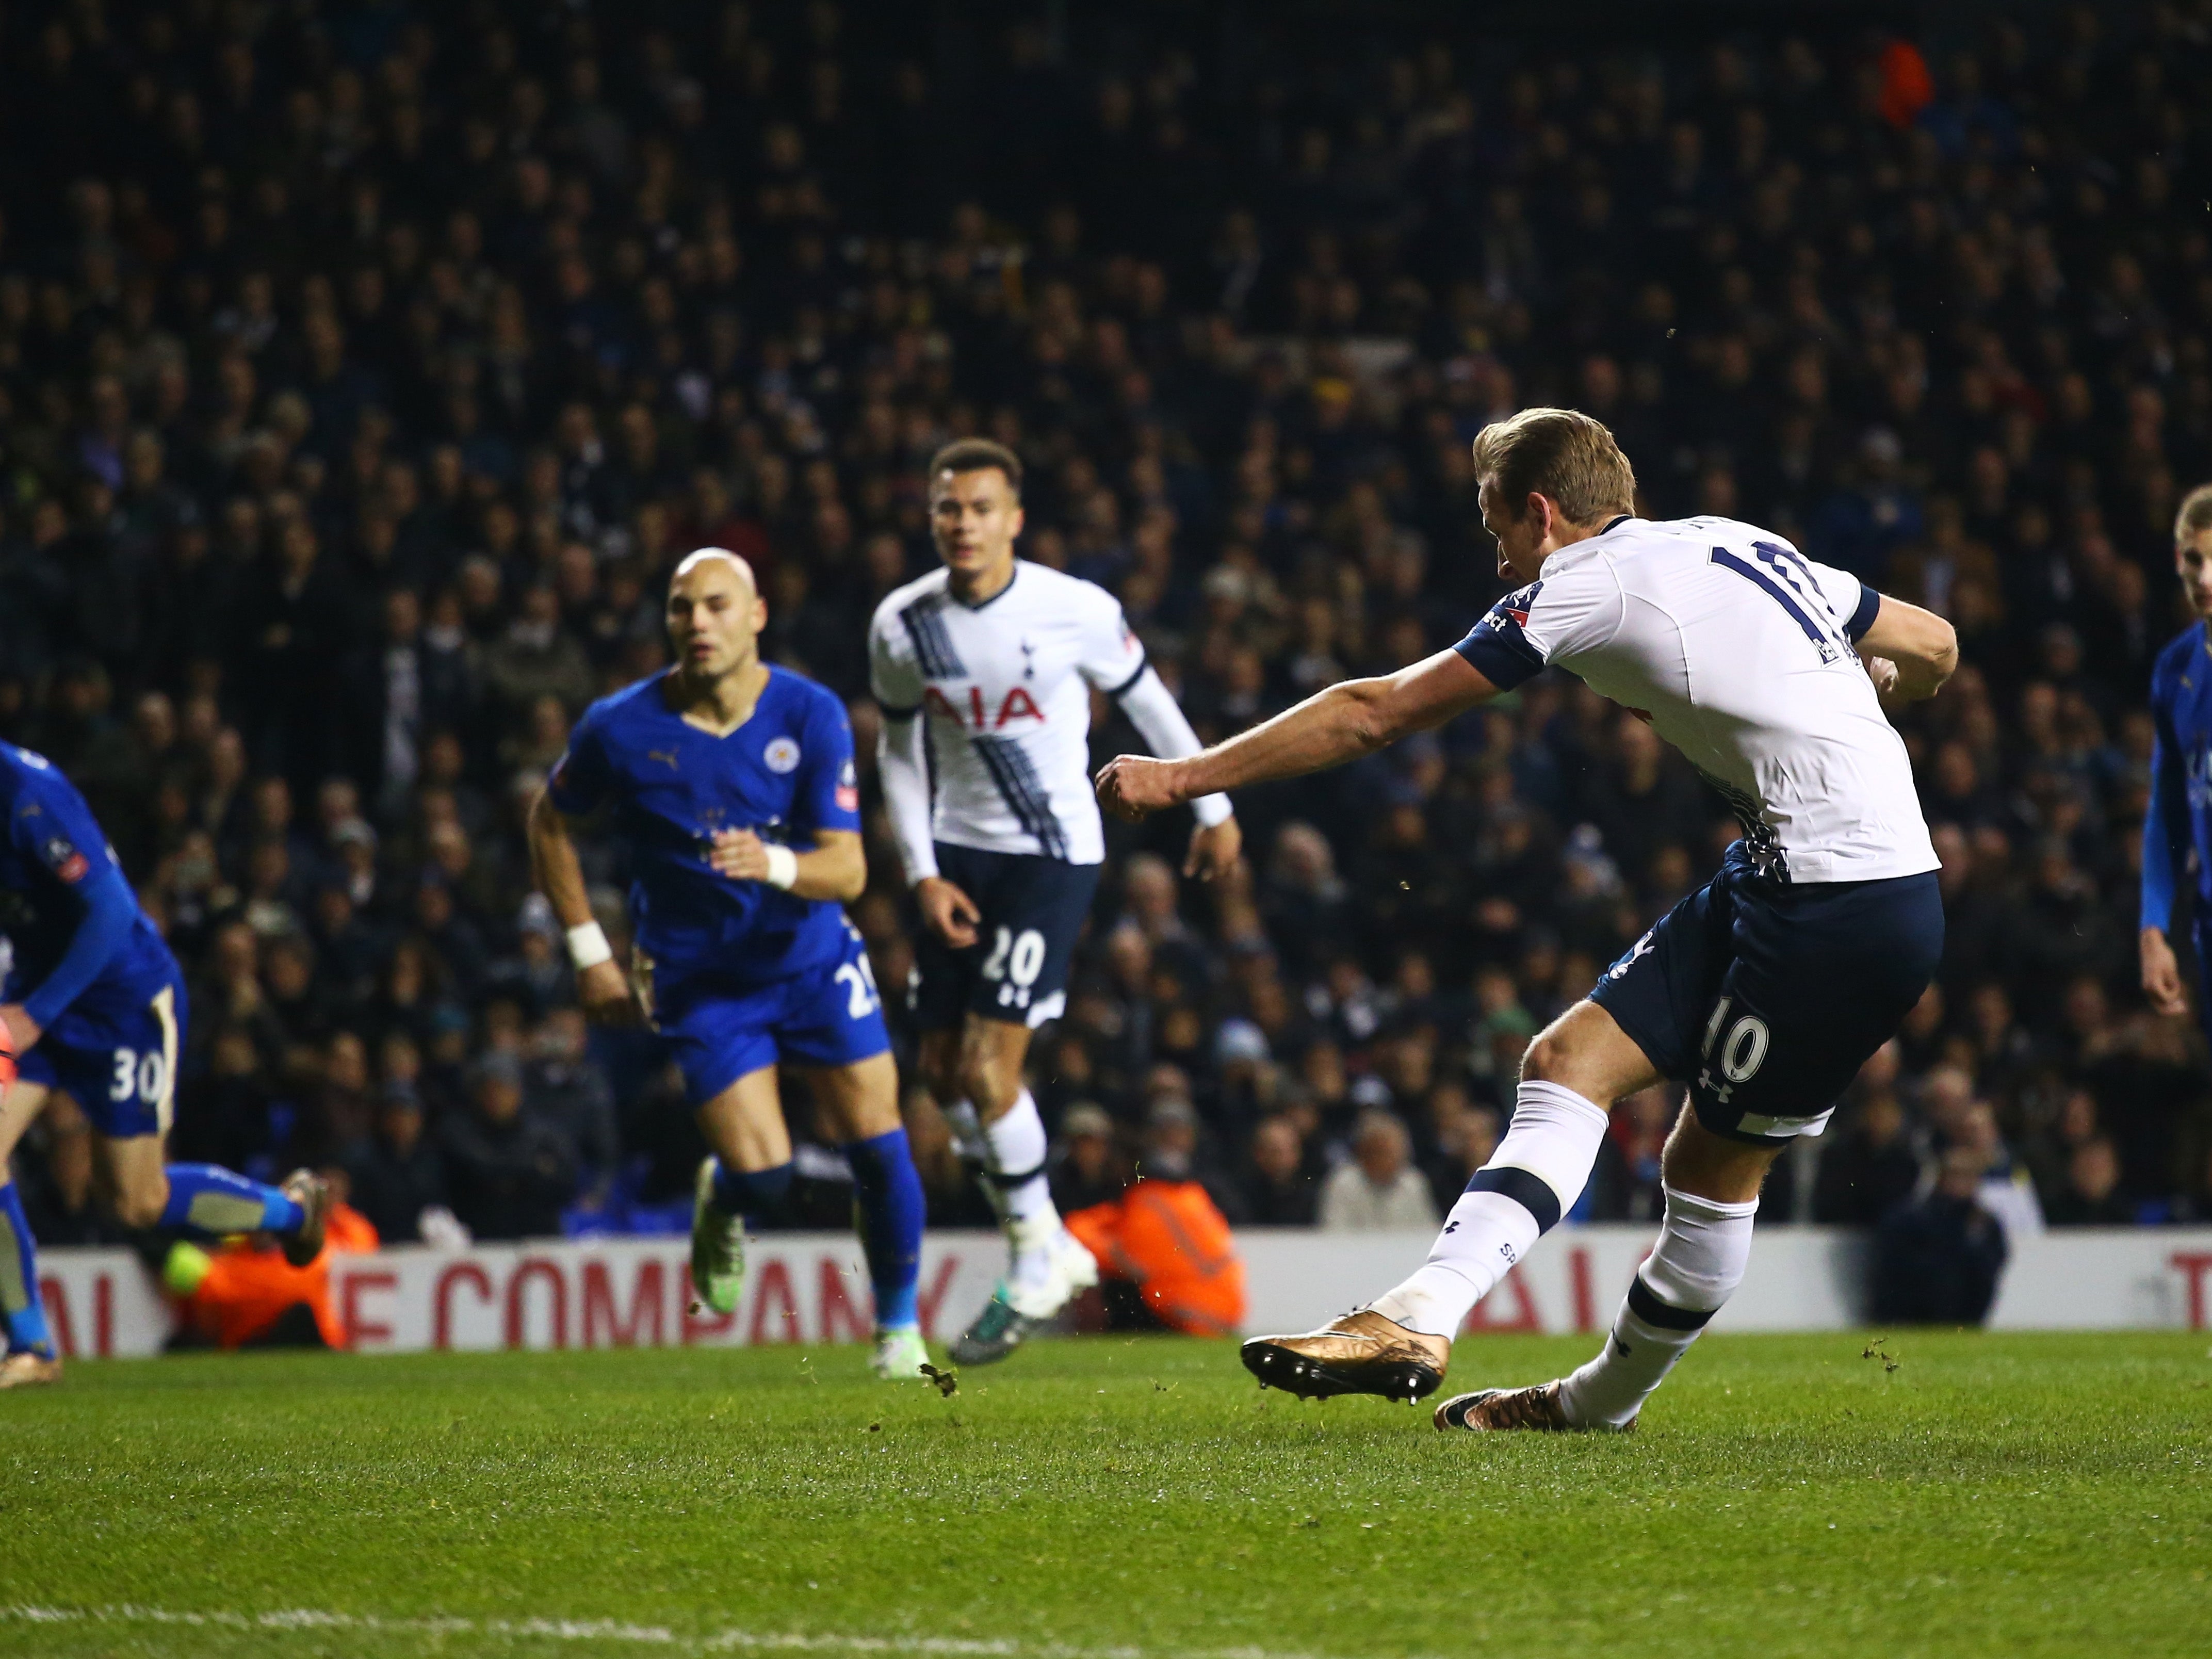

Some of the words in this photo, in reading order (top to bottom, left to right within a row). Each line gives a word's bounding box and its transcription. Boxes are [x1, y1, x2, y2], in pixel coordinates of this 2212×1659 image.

[1706, 540, 1863, 669] 10
[924, 685, 1046, 731] AIA
[982, 926, 1046, 987] 20
[1702, 996, 1769, 1083] 10
[108, 1047, 168, 1103] 30
